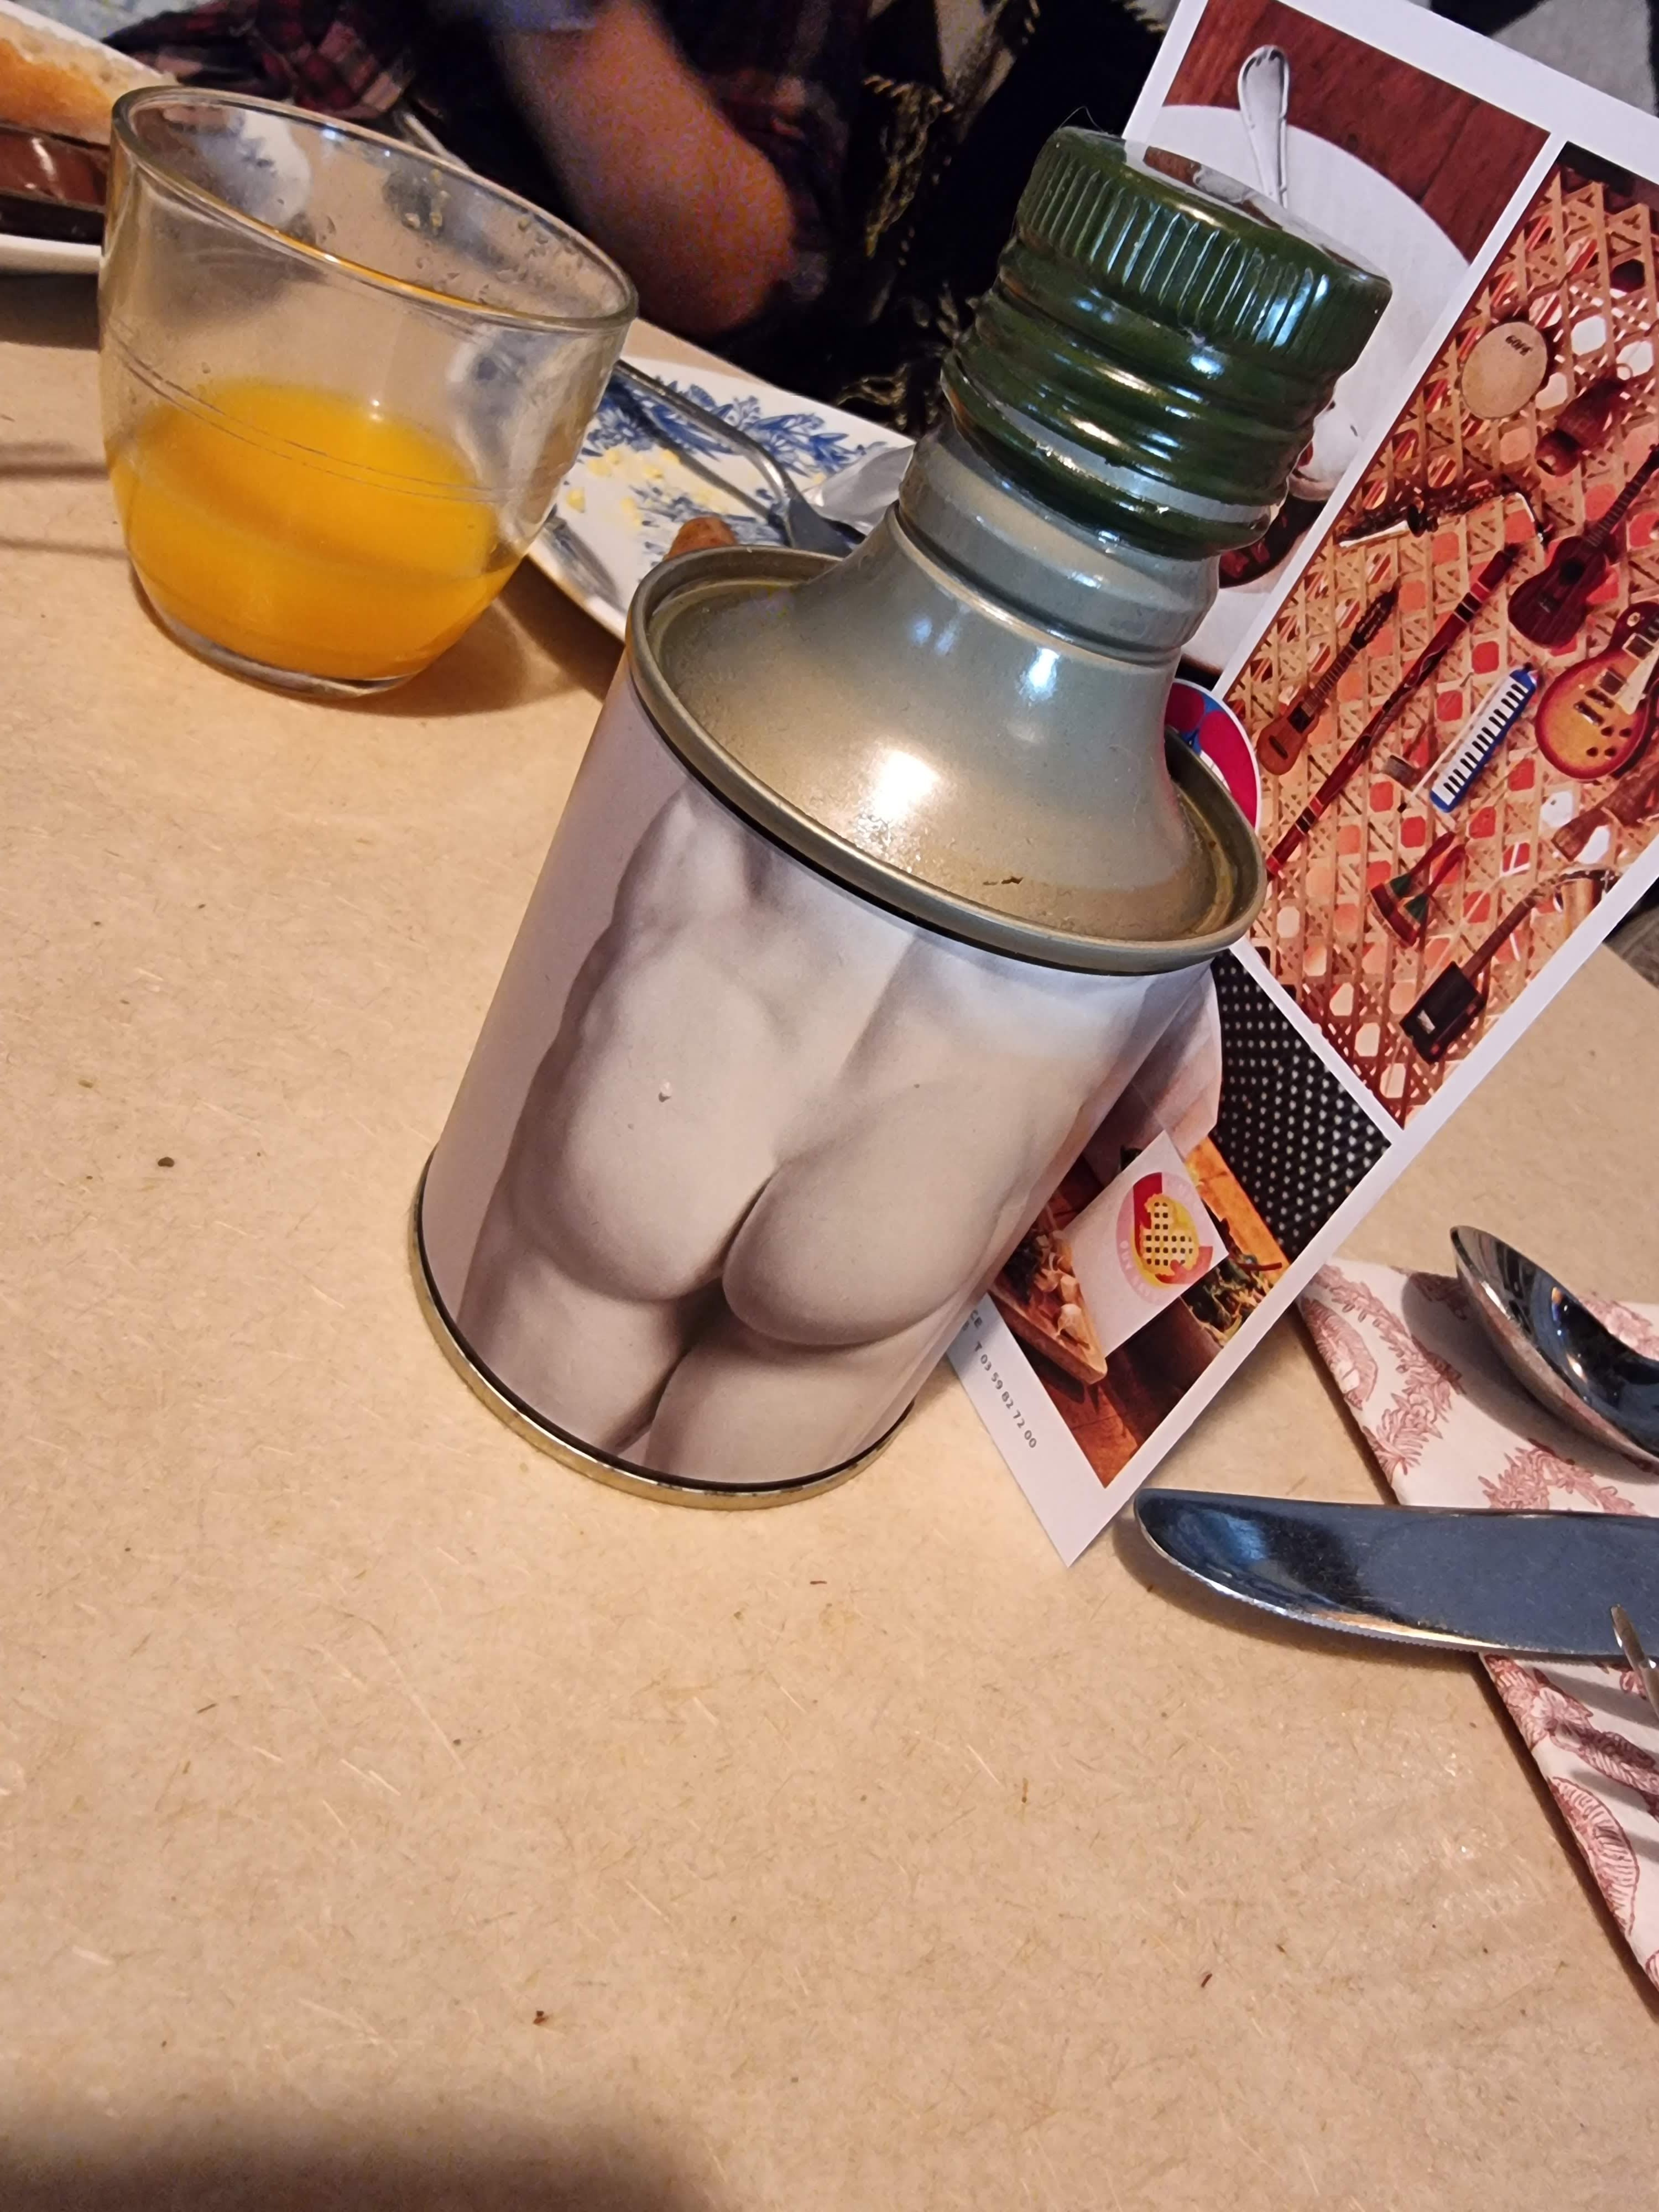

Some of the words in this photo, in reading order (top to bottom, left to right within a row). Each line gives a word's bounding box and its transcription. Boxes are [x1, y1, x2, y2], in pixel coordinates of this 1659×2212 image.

[980, 1354, 992, 1371] 03
[991, 1372, 1003, 1389] 59
[1001, 1391, 1014, 1409] 82
[1013, 1410, 1025, 1428] 72
[1024, 1430, 1037, 1448] 00
